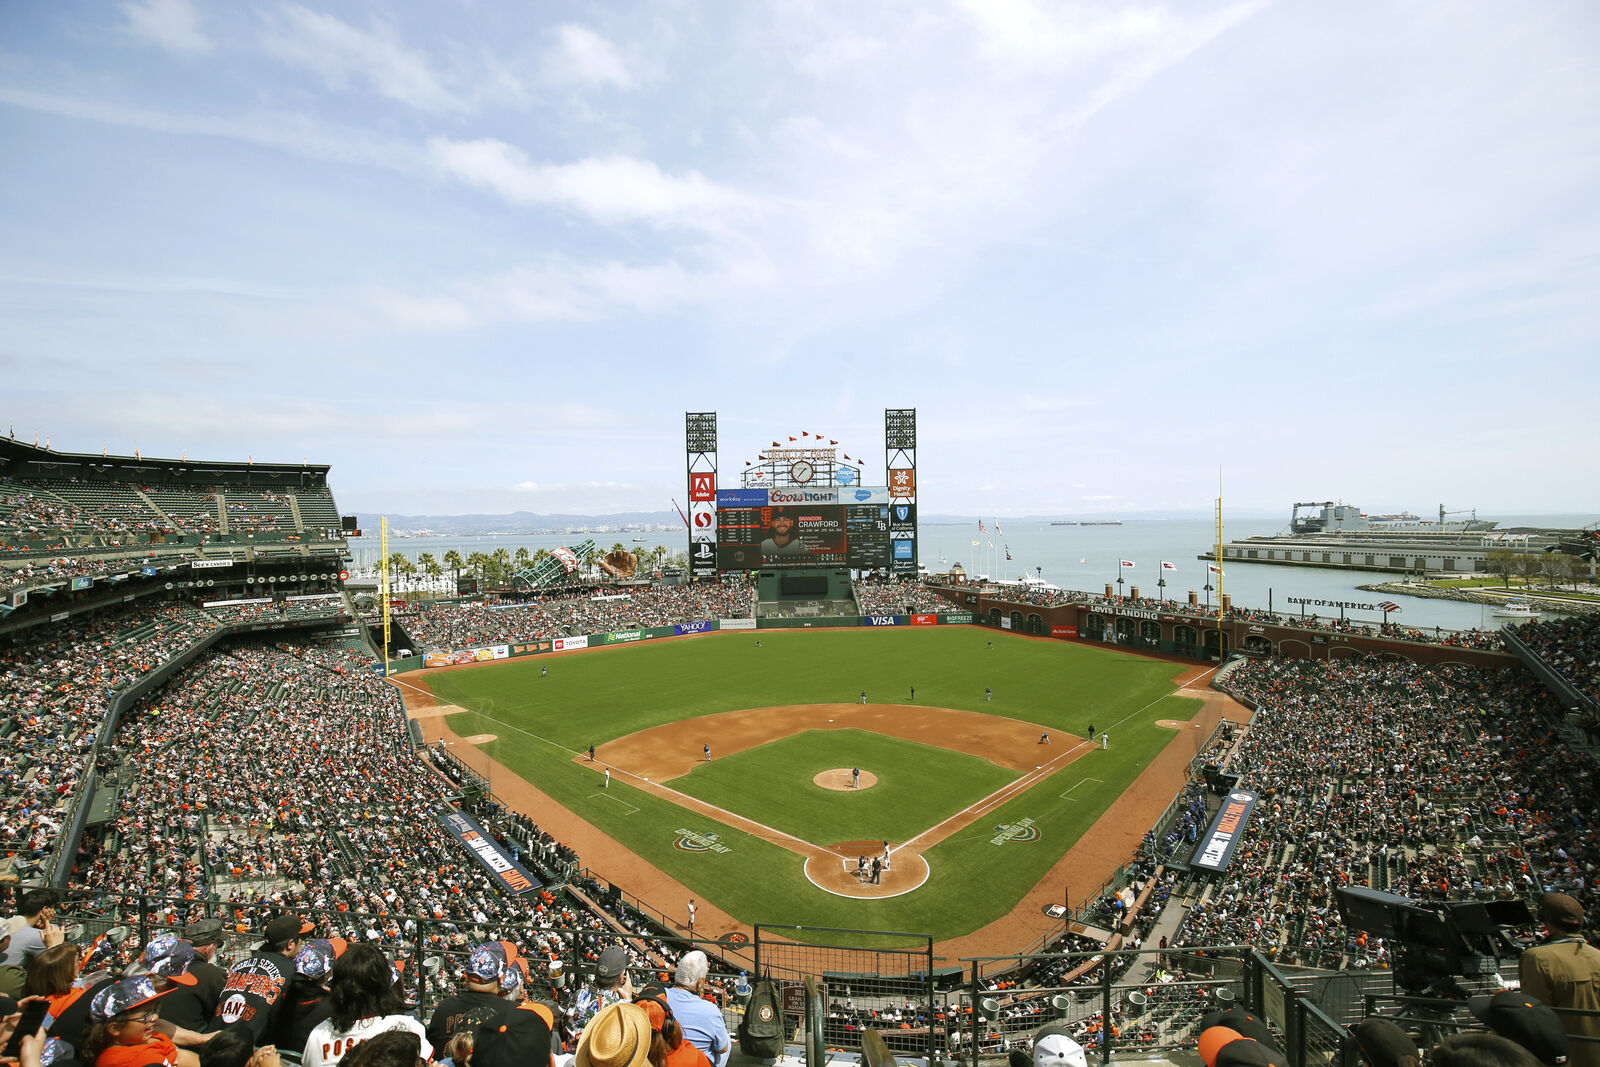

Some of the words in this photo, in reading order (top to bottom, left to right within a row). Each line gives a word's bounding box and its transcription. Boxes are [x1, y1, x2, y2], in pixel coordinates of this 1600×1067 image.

[770, 490, 803, 502] Coors
[804, 492, 833, 501] LIGHT
[798, 520, 838, 528] CRAWFORD
[1288, 596, 1312, 606] BANK
[1328, 601, 1375, 611] AMERICA
[1116, 608, 1158, 620] LANDING
[871, 616, 895, 626] VISA
[616, 631, 640, 640] National
[674, 828, 715, 847] OPENING
[708, 843, 733, 854] DAY
[1211, 831, 1233, 840] TO
[1198, 837, 1229, 867] WELCOME
[497, 868, 533, 892] GIANTS
[258, 958, 282, 981] SERIES
